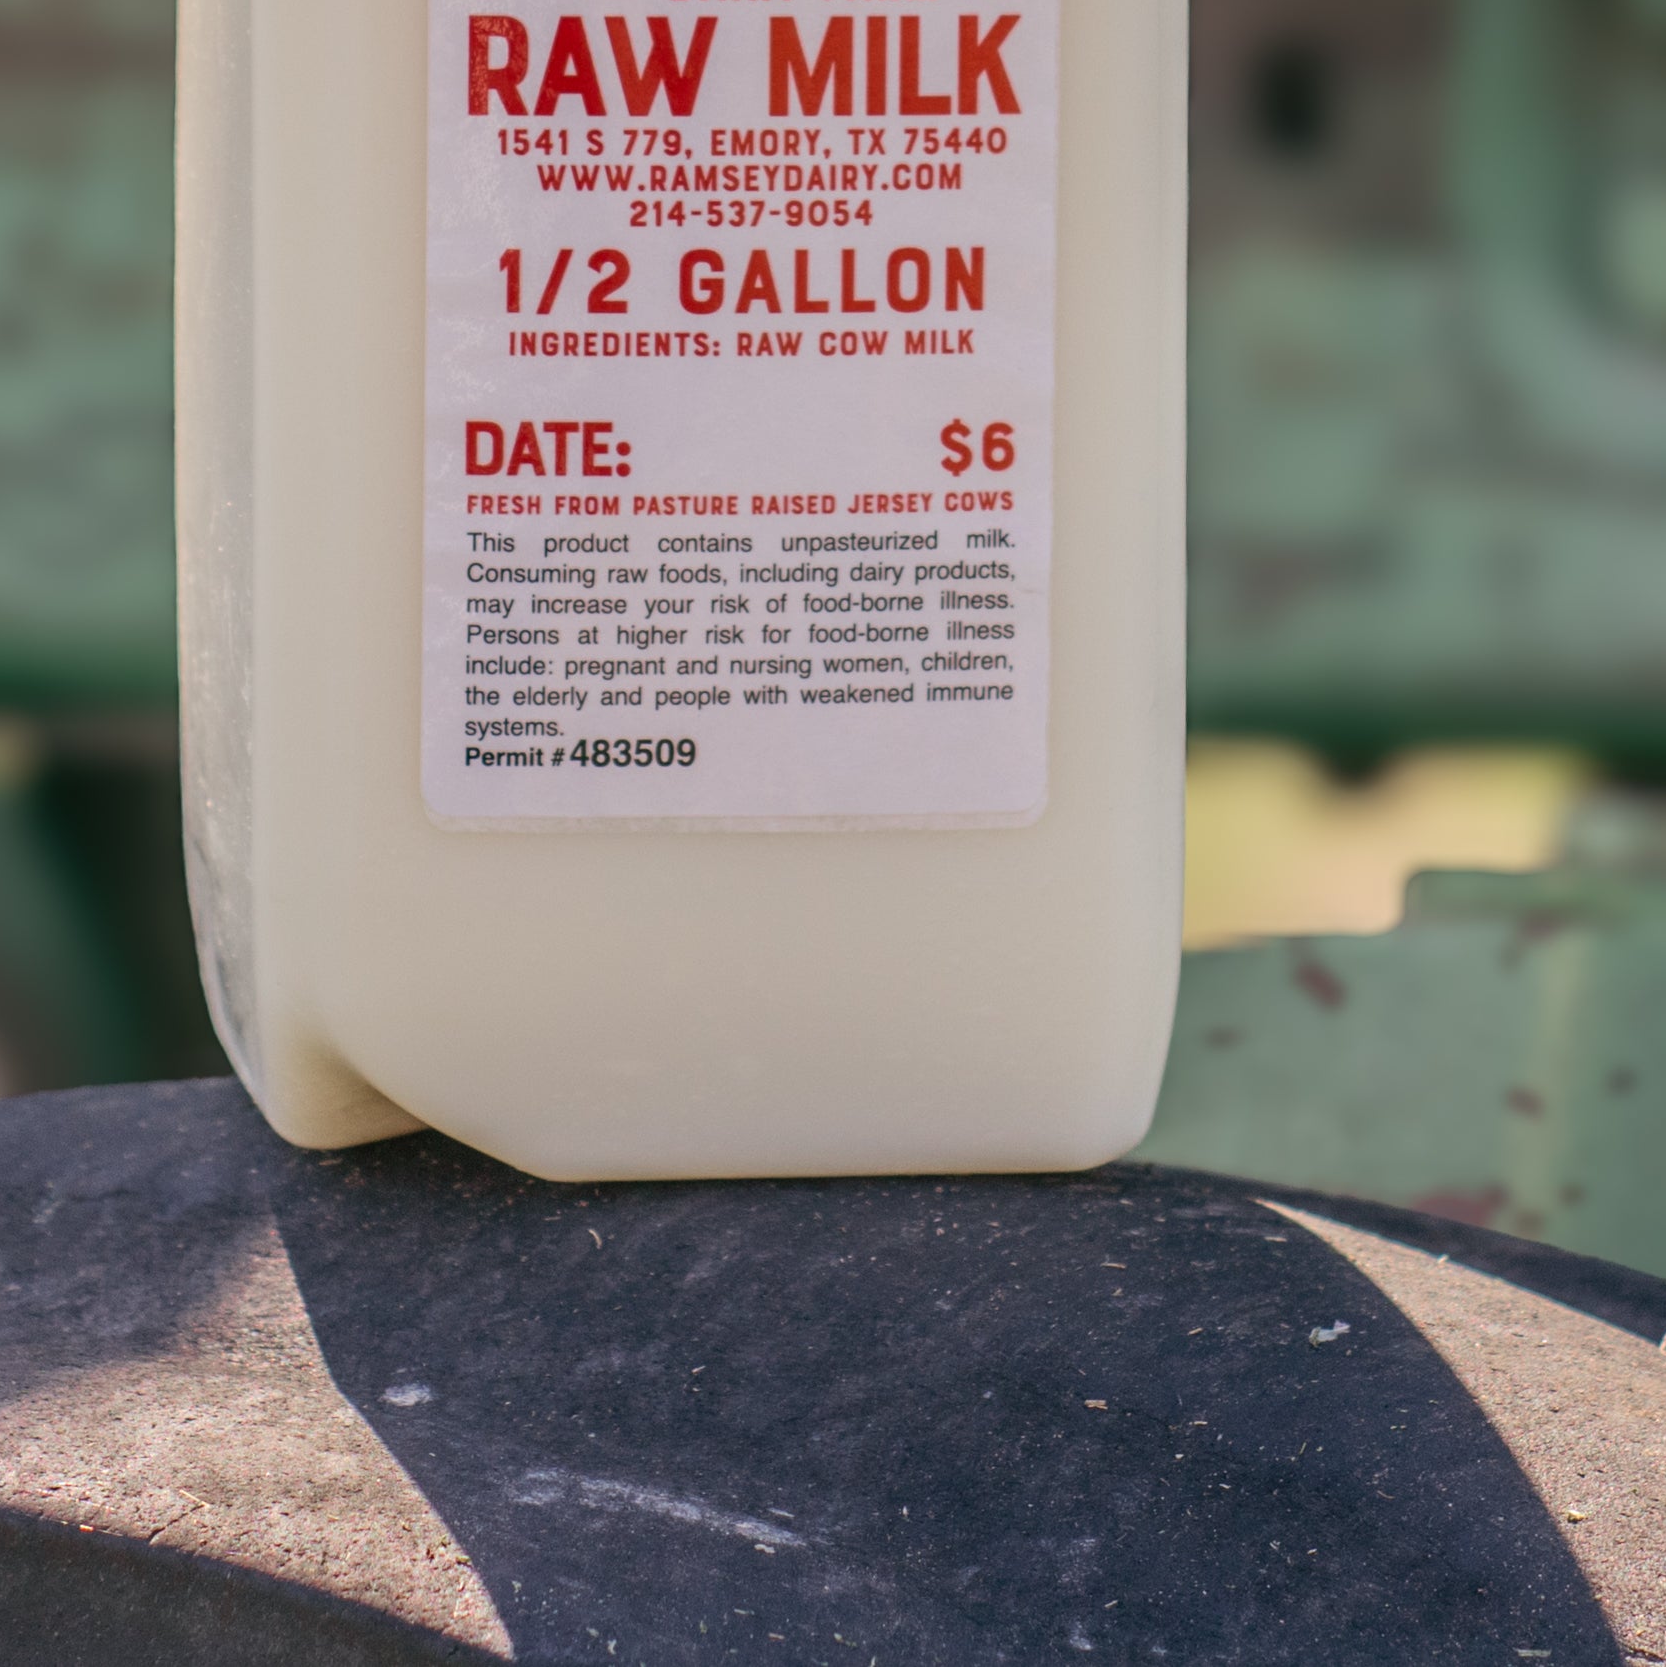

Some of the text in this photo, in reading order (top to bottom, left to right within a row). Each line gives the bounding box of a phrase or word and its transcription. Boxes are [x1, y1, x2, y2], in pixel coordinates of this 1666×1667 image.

[466, 13, 1023, 118] RAW MILK
[497, 126, 1008, 161] 1541 S 779, EMORY, TX 75440
[536, 162, 963, 193] WWW.RAMSEYDAIRY.COM
[629, 198, 874, 228] 214-537-9054
[498, 245, 986, 316] 1/2 GALLON
[508, 328, 975, 358] INGREDIENTS: RAW COW MILK
[464, 417, 1016, 479] DATE: $6
[466, 490, 1015, 517] FRESH FROM PASTURE RAISED JERSEY COWS
[466, 528, 1016, 559] This product contains unpasteurized milk.
[466, 559, 1016, 590] Consuming raw foods, including dairy products,
[466, 589, 1016, 620] may increase your risk of food-borne illness.
[466, 620, 1015, 651] Persons at higher risk for food-borne illness
[465, 650, 1014, 681] include: pregnant and nursing women, children,
[464, 681, 1014, 712] the elderly and people with weakened immune
[464, 717, 565, 742] systems.
[464, 737, 697, 768] Permit # 483509
